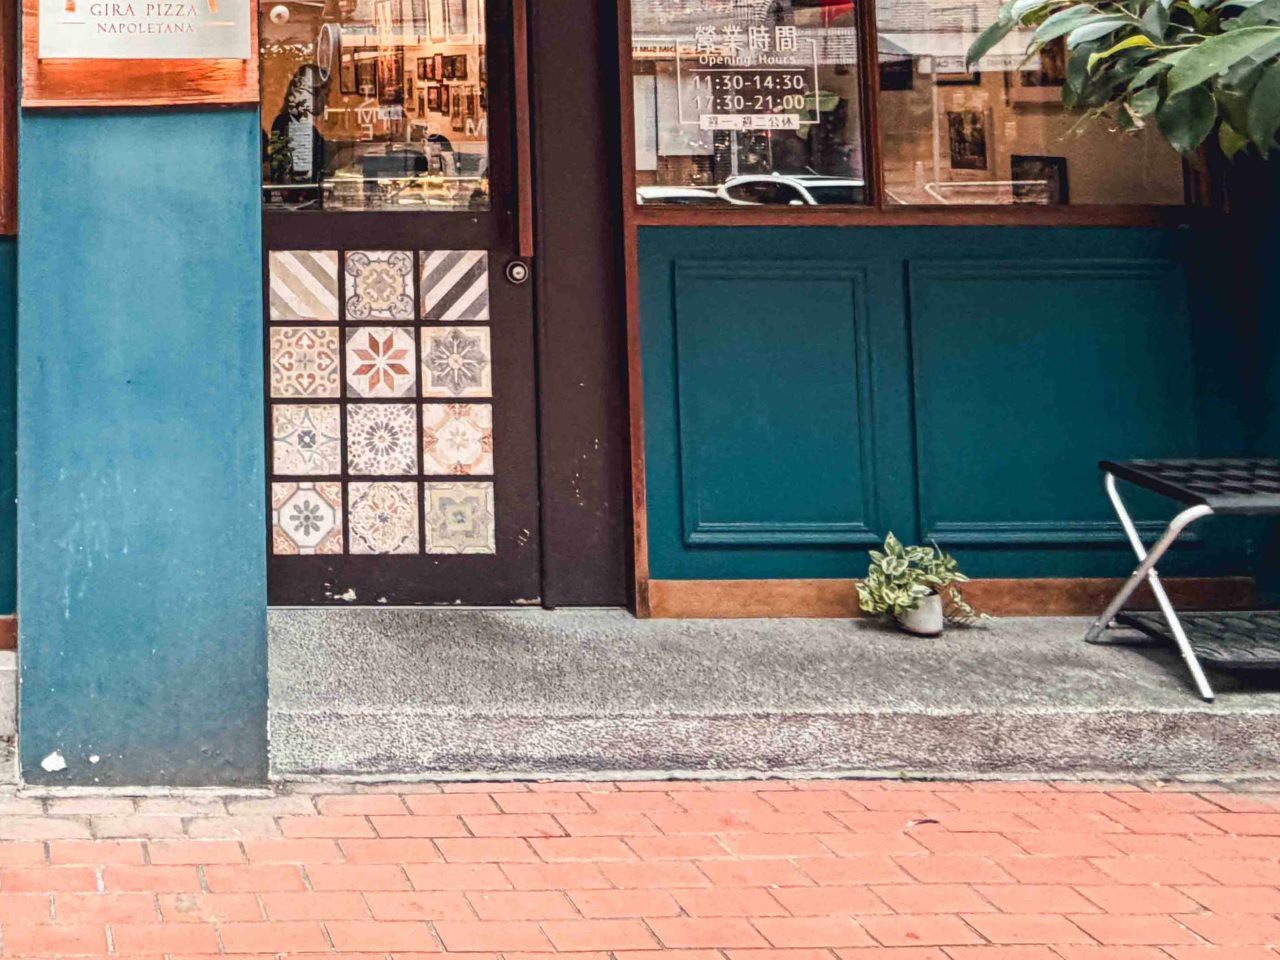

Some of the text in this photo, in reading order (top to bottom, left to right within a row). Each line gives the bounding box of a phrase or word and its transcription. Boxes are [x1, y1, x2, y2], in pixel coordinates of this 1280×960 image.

[90, 3, 198, 17] GIRA PIZZA
[97, 23, 194, 34] NAPOLETANA
[695, 24, 797, 53] 營業時間
[699, 55, 795, 67] Opening Hours
[693, 75, 804, 90] 11:30-14:30
[693, 95, 805, 110] 17:30-21:00
